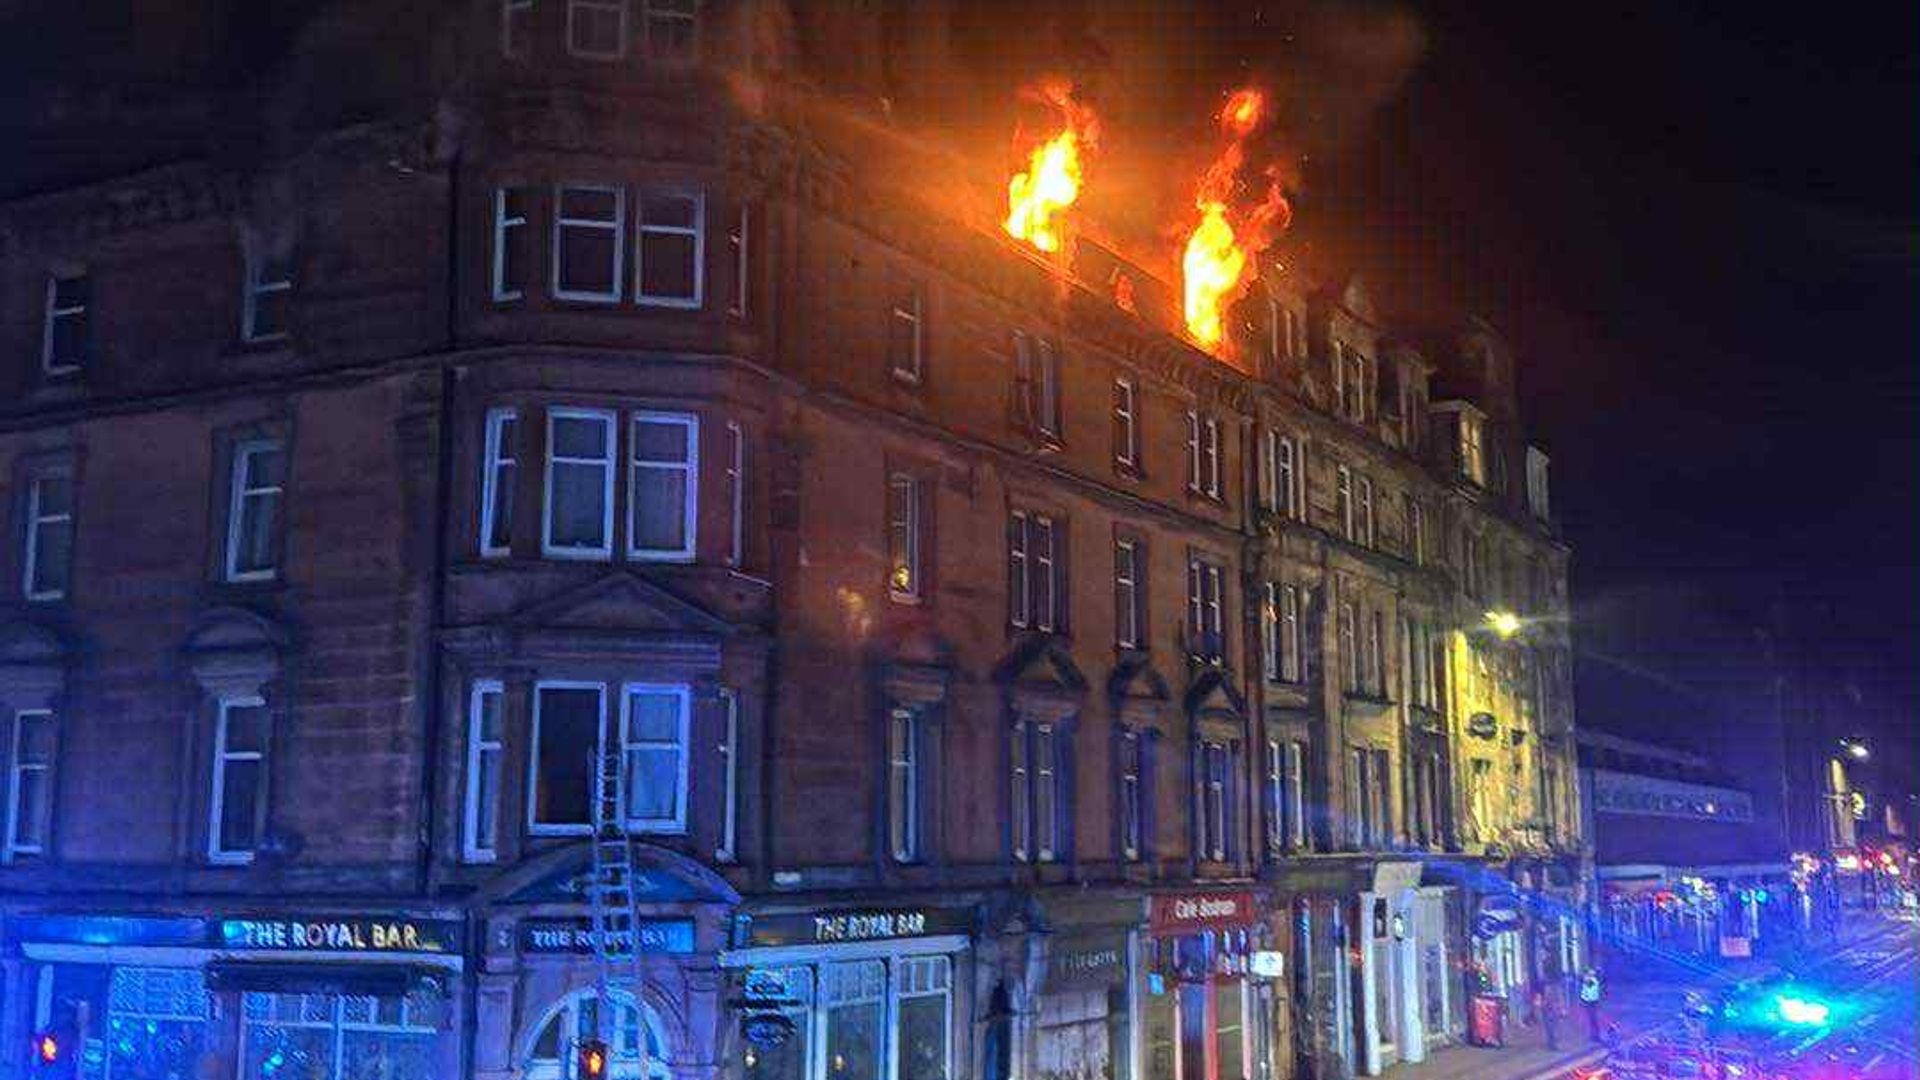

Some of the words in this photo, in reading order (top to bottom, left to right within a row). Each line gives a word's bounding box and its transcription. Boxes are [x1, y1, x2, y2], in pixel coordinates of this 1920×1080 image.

[242, 920, 287, 947] THE
[292, 921, 366, 949] ROYAL
[371, 924, 420, 949] BAR
[532, 929, 571, 948] THE
[815, 917, 846, 940] THE
[848, 914, 895, 939] ROYAL
[897, 912, 925, 937] BAR
